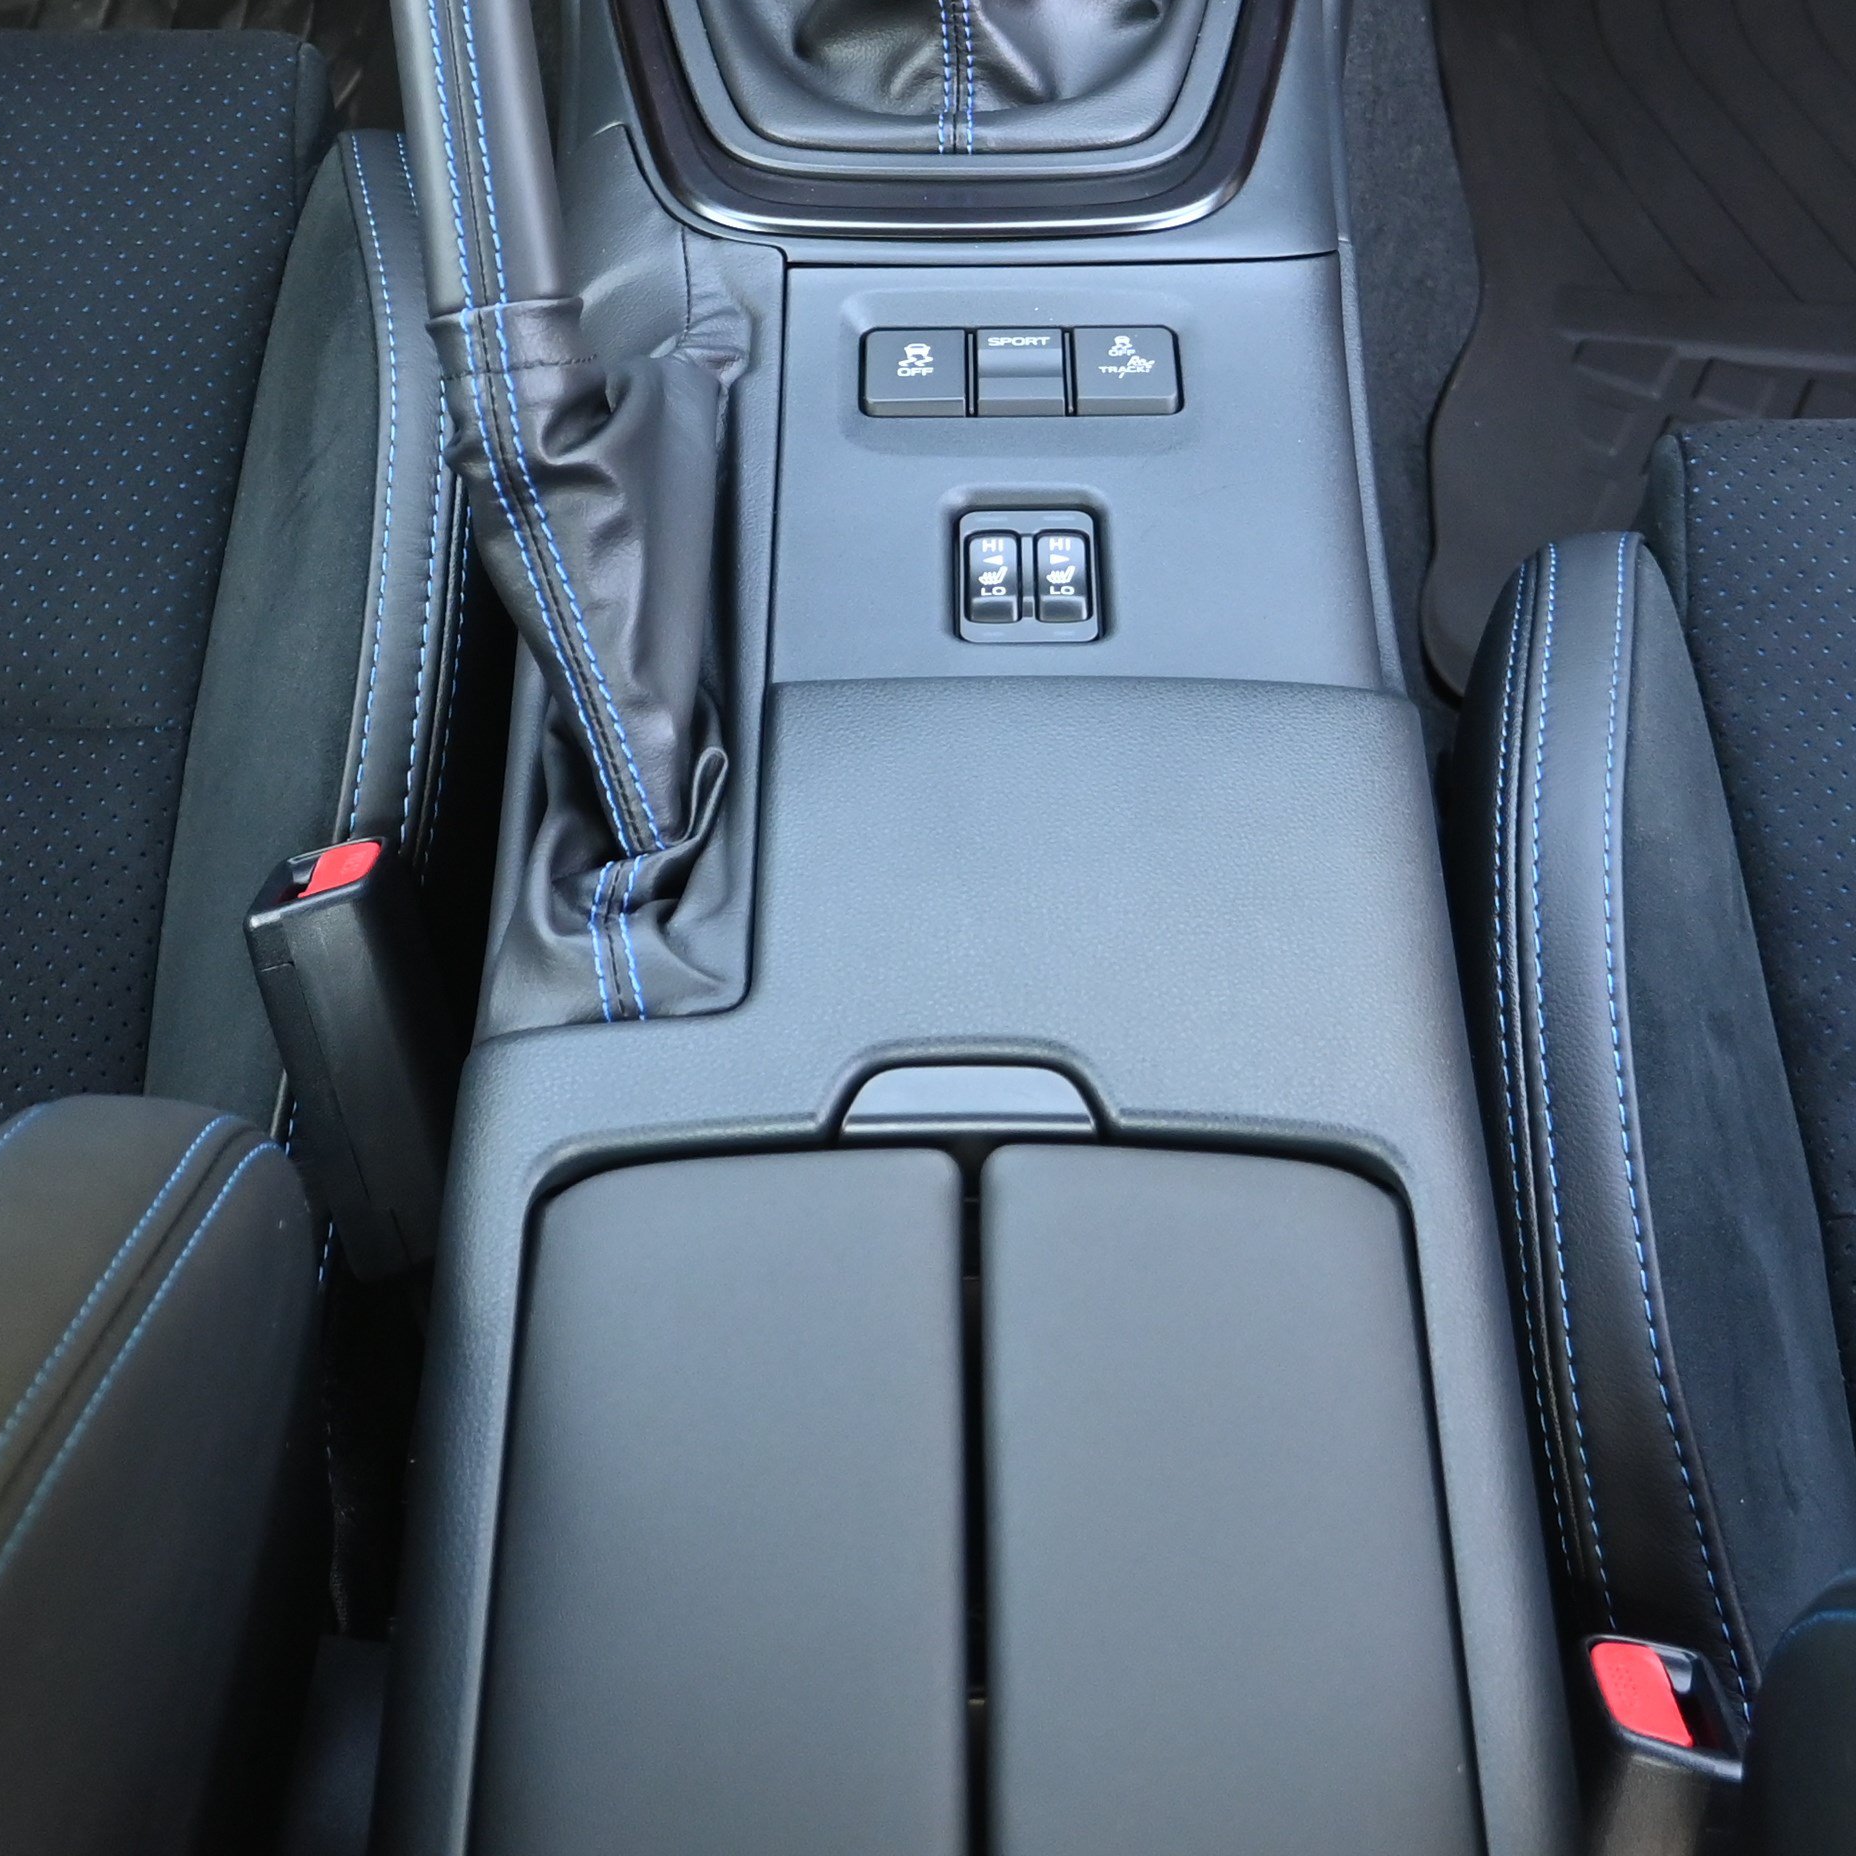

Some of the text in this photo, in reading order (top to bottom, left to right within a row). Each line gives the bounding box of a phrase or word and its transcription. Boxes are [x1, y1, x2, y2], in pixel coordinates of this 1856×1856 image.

[987, 334, 1051, 348] SPORT
[896, 366, 934, 378] OFF
[981, 538, 1005, 553] HI
[1049, 537, 1072, 552] HI
[980, 586, 1007, 597] LO
[1049, 585, 1075, 596] LO
